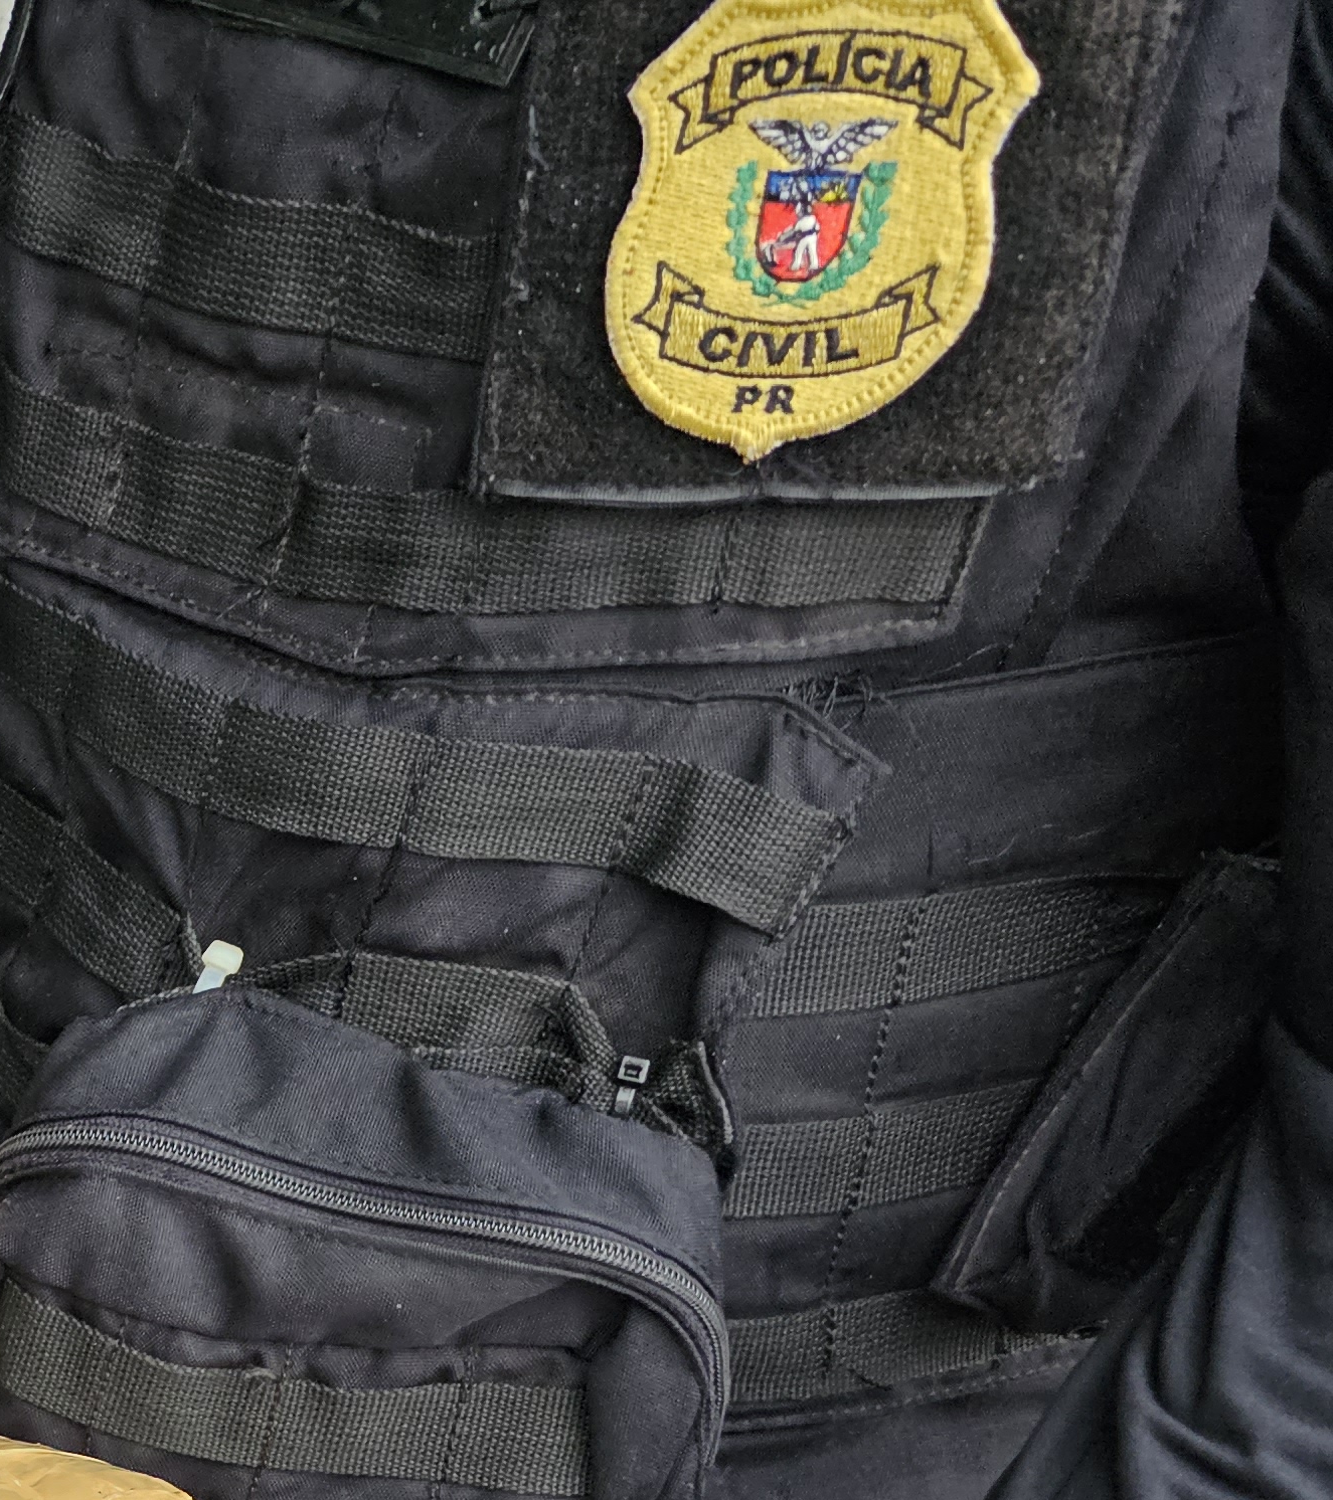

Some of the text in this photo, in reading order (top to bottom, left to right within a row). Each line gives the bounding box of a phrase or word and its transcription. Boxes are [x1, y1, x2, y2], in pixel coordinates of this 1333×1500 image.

[730, 31, 930, 99] POLÍCIA
[699, 326, 859, 368] CIVIL
[731, 385, 795, 414] PR
